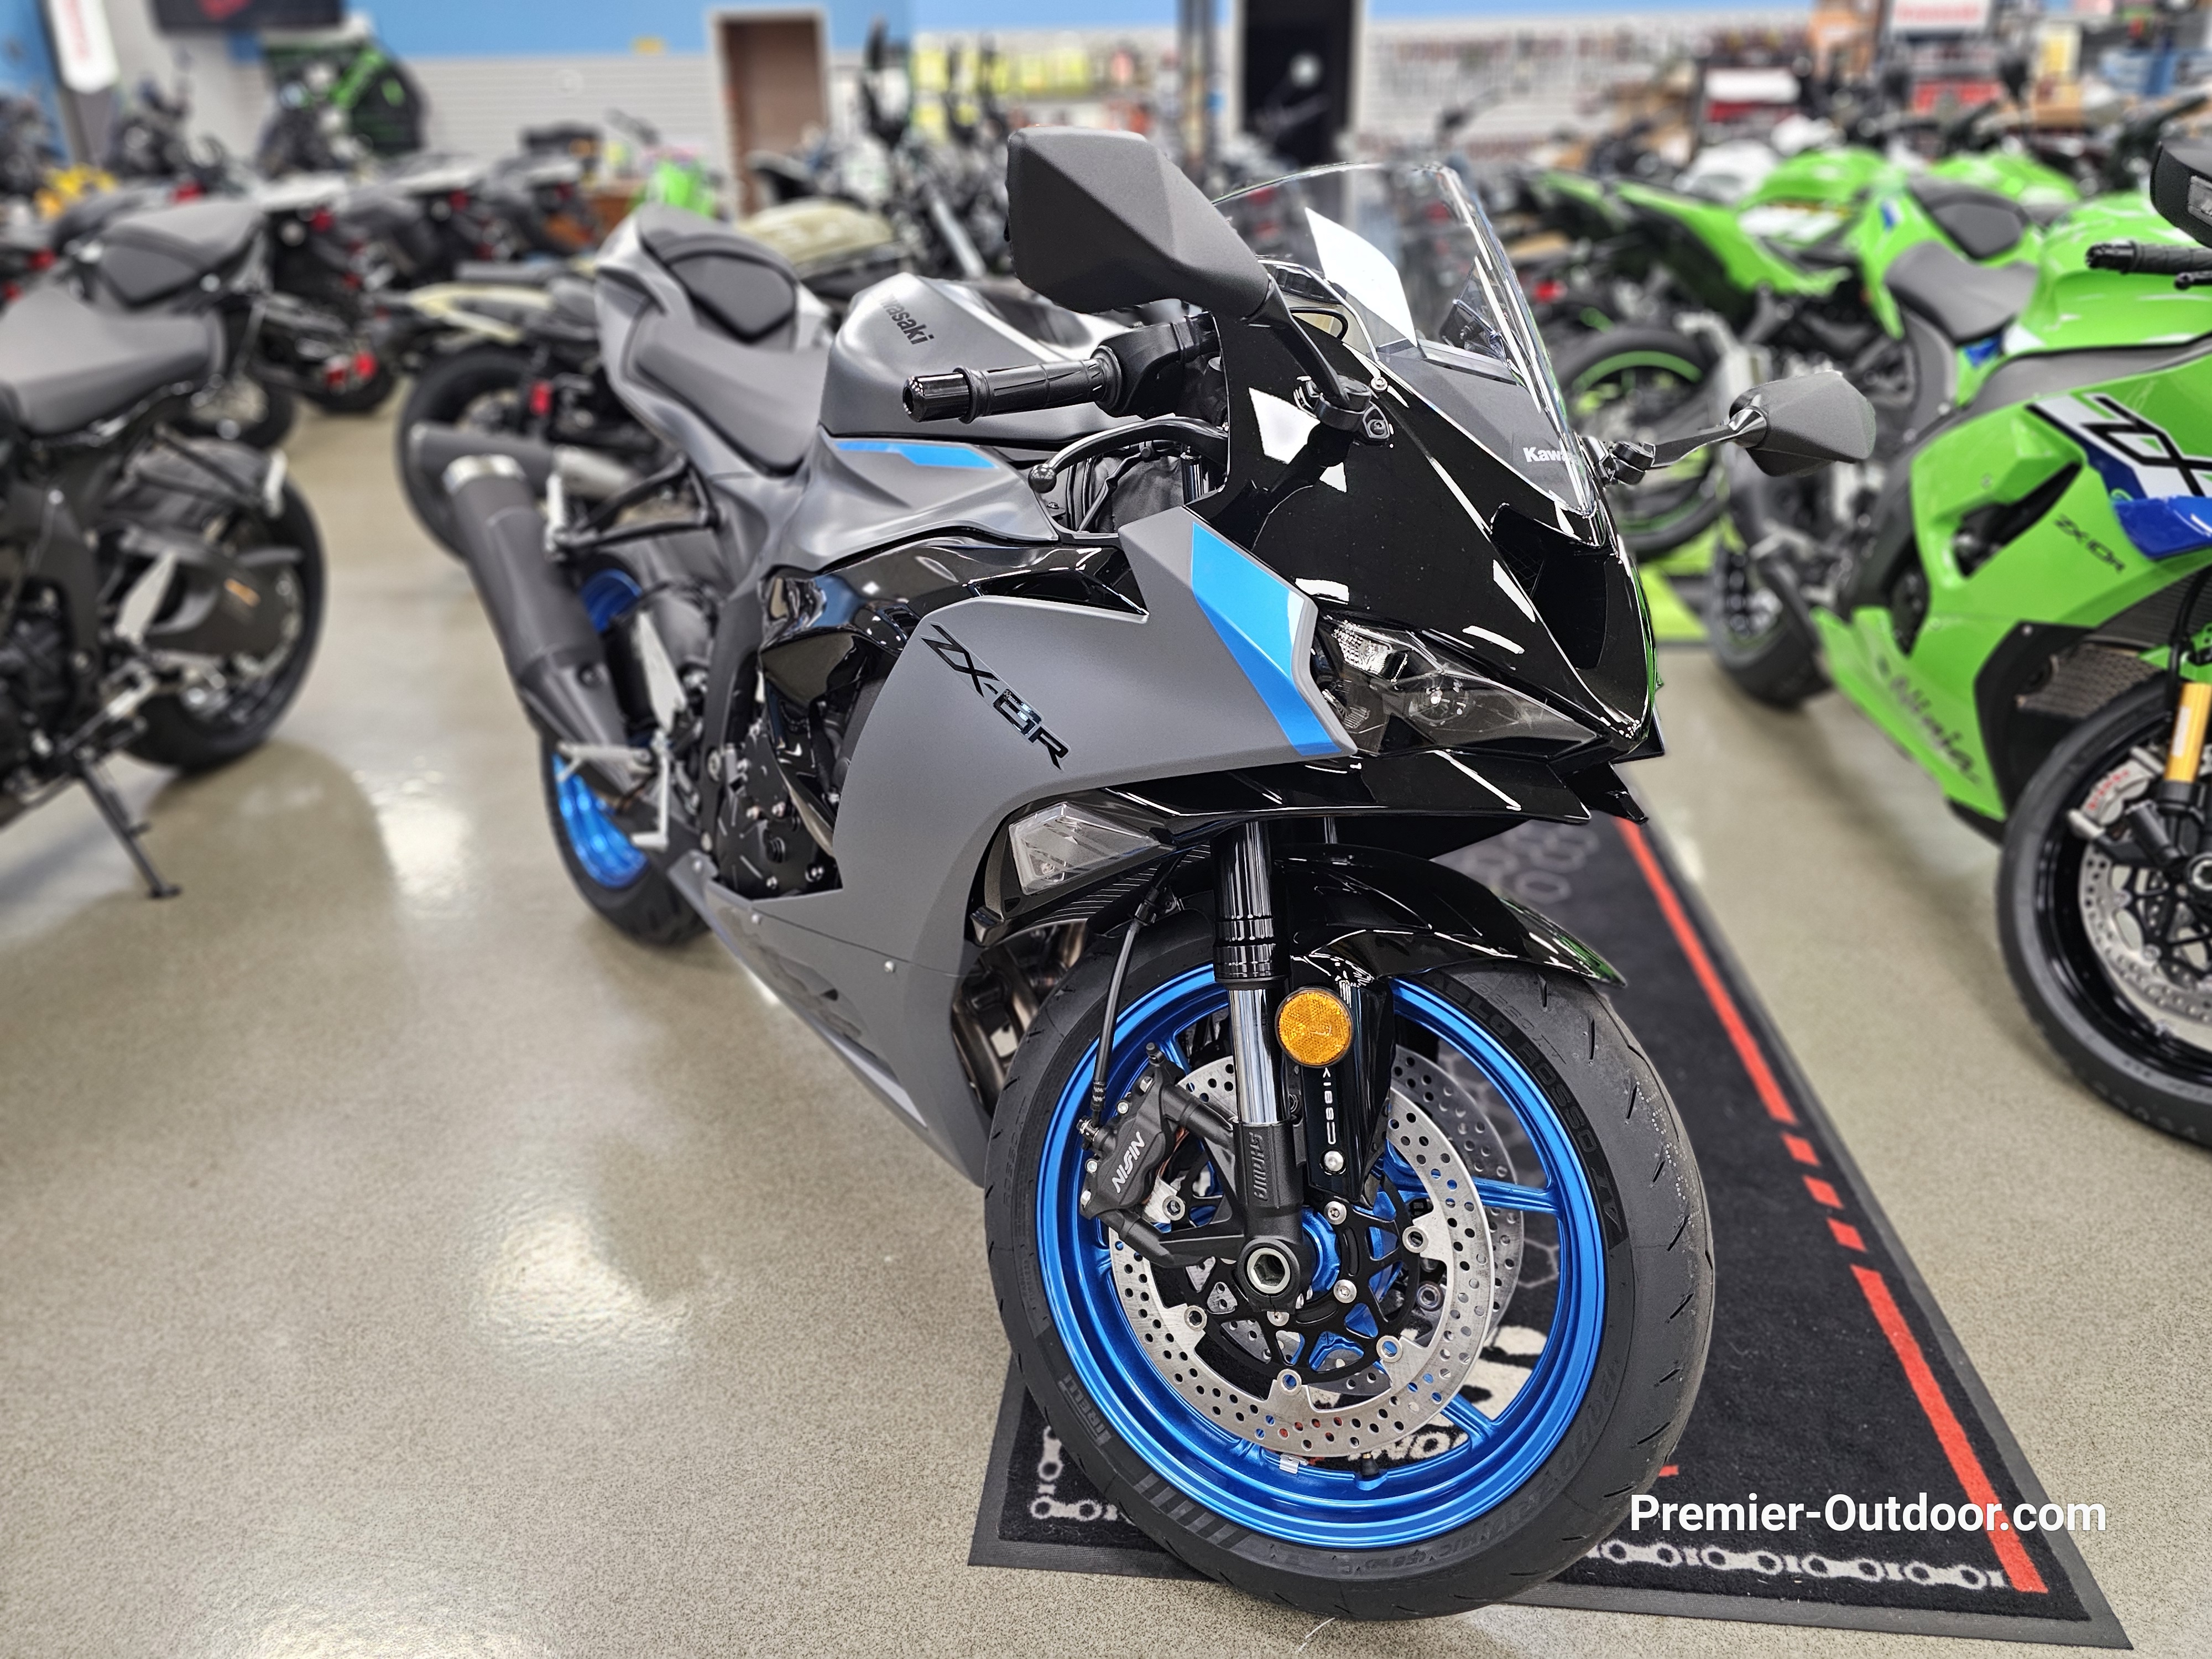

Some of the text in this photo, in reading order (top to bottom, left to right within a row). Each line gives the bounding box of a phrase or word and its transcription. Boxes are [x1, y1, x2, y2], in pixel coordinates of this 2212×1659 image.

[880, 294, 935, 345] wasaki
[921, 623, 1069, 770] ZX-6R
[1422, 972, 1513, 1037] ABLO
